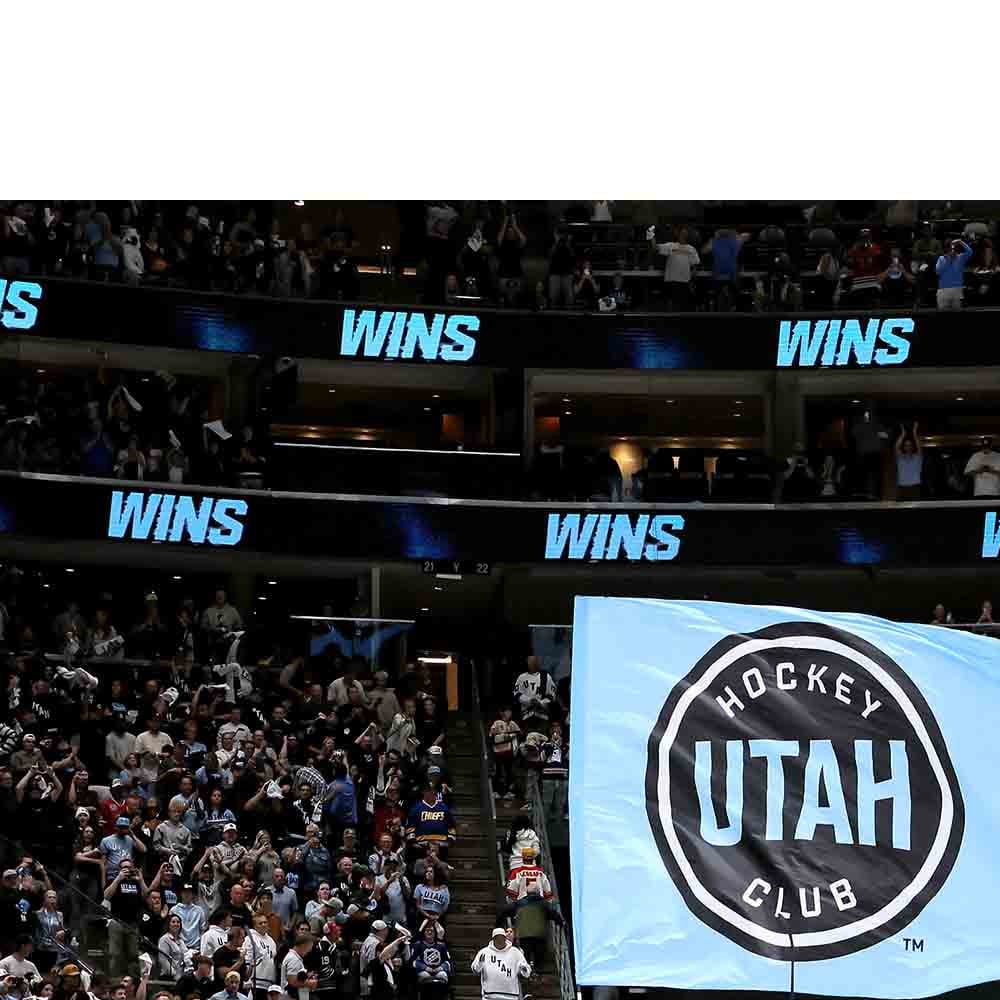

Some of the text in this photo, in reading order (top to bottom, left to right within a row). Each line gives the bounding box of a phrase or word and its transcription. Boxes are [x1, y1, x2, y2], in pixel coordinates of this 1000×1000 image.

[340, 310, 480, 361] WINS
[777, 318, 915, 367] WINS
[108, 491, 248, 546] WINS
[545, 513, 685, 562] WINS
[714, 661, 882, 719] HOCKEY
[694, 739, 912, 850] UTAH
[741, 877, 857, 919] CLUB
[490, 955, 512, 978] UTAH
[903, 938, 924, 952] TM
